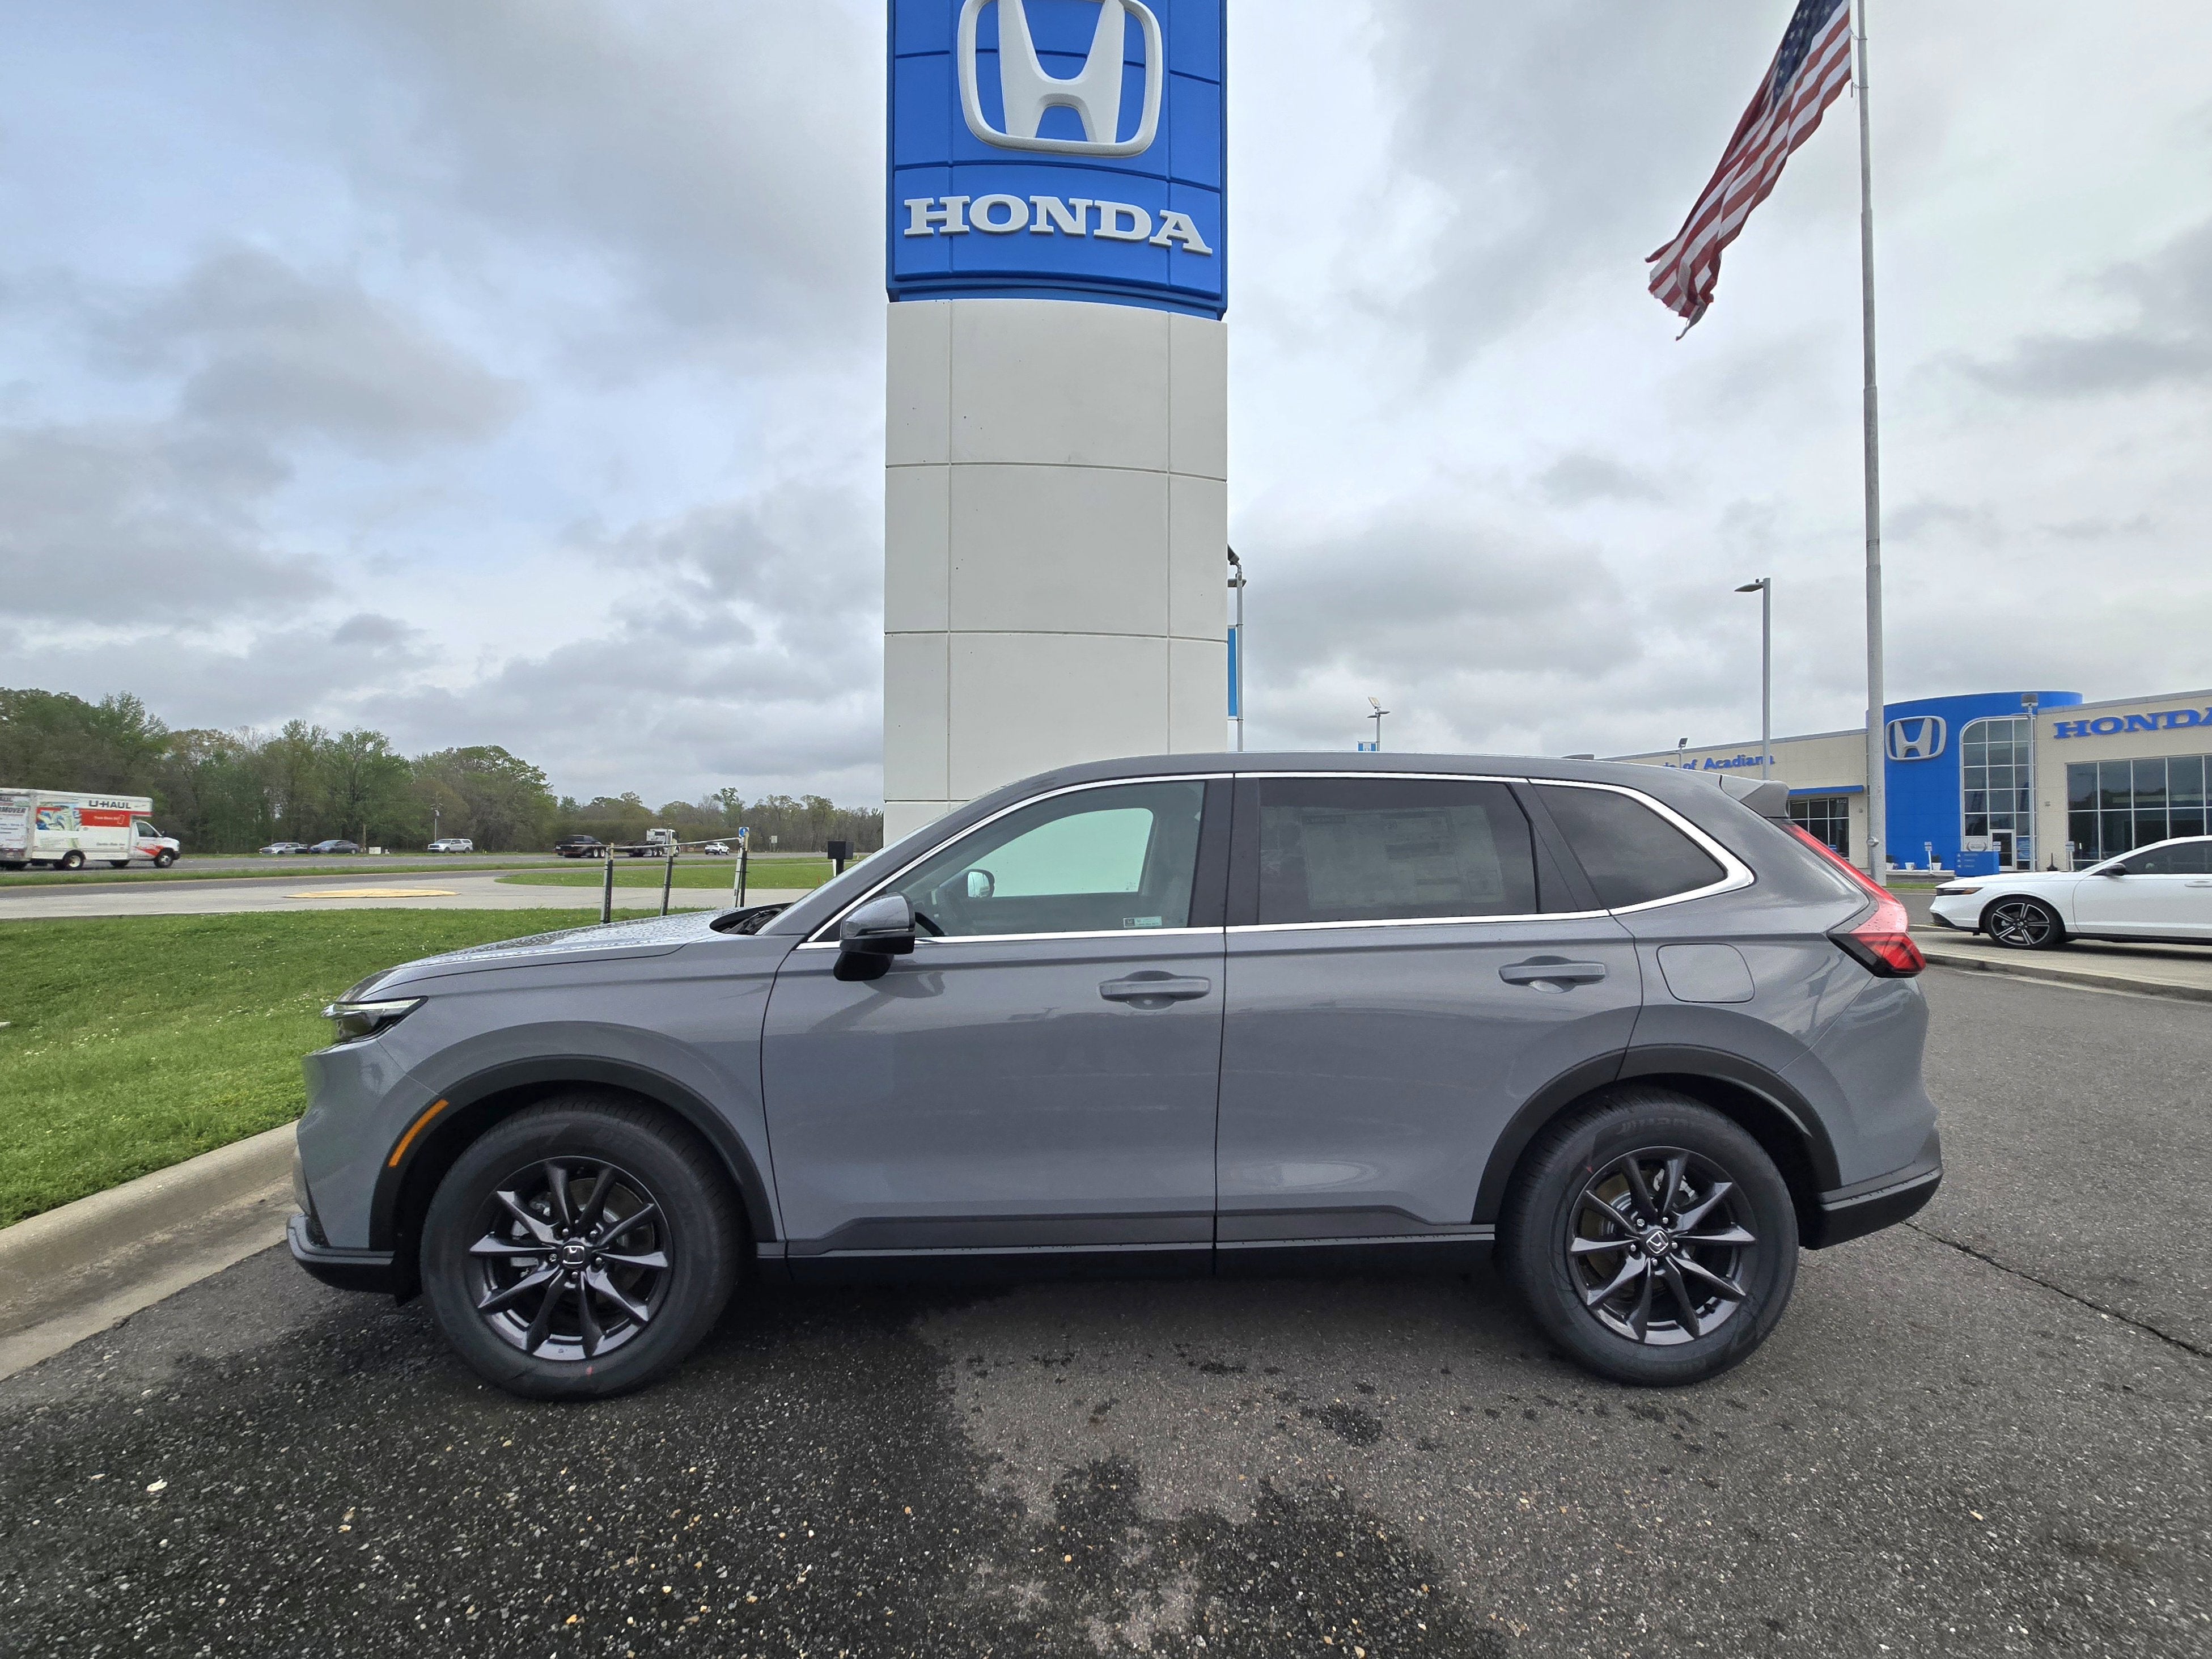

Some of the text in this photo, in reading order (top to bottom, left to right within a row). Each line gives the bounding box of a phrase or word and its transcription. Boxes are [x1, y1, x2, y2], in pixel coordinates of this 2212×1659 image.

[904, 193, 1213, 256] HONDA
[1683, 759, 1698, 769] of
[88, 800, 132, 809] U-HAUL
